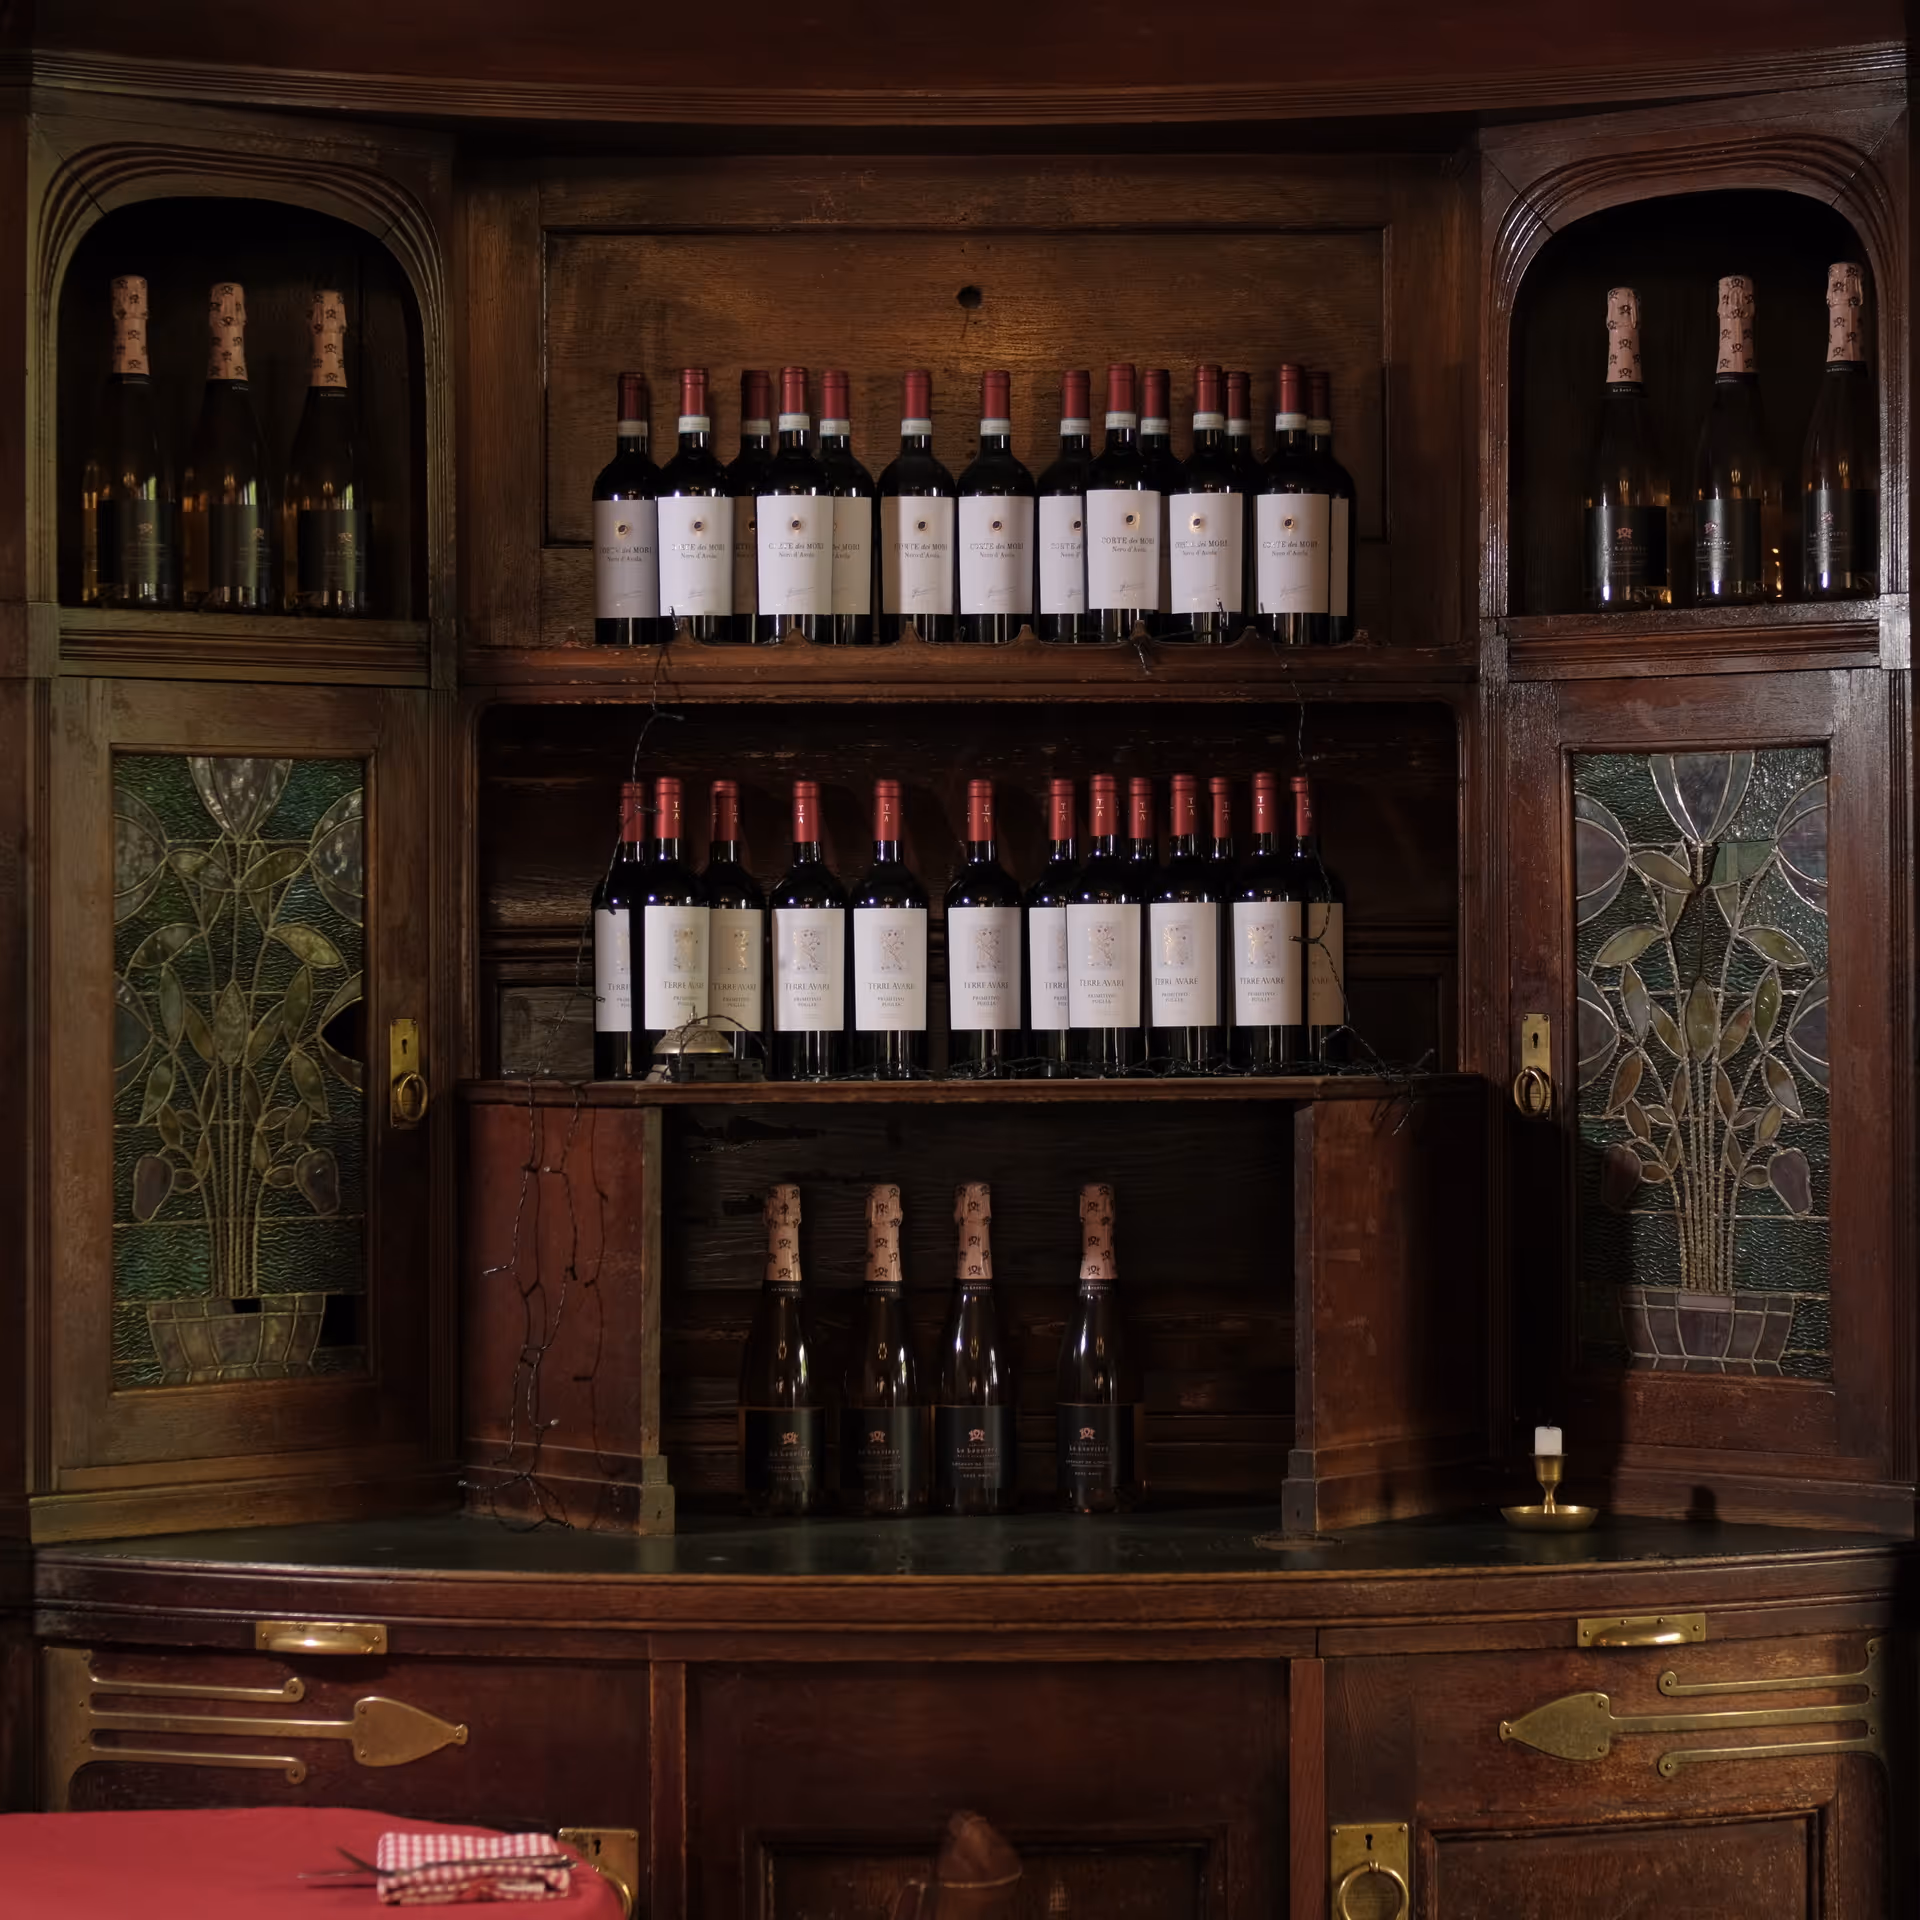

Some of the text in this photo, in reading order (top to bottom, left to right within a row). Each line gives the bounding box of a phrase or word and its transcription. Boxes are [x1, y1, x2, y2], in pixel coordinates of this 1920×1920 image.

[1101, 537, 1128, 545] CORTE
[1208, 539, 1228, 548] MORI
[633, 546, 652, 554] MORI
[1080, 979, 1101, 987] TERRE
[1174, 977, 1199, 985] AVARE
[1262, 976, 1285, 984] AVARE
[664, 981, 687, 989] TERRE
